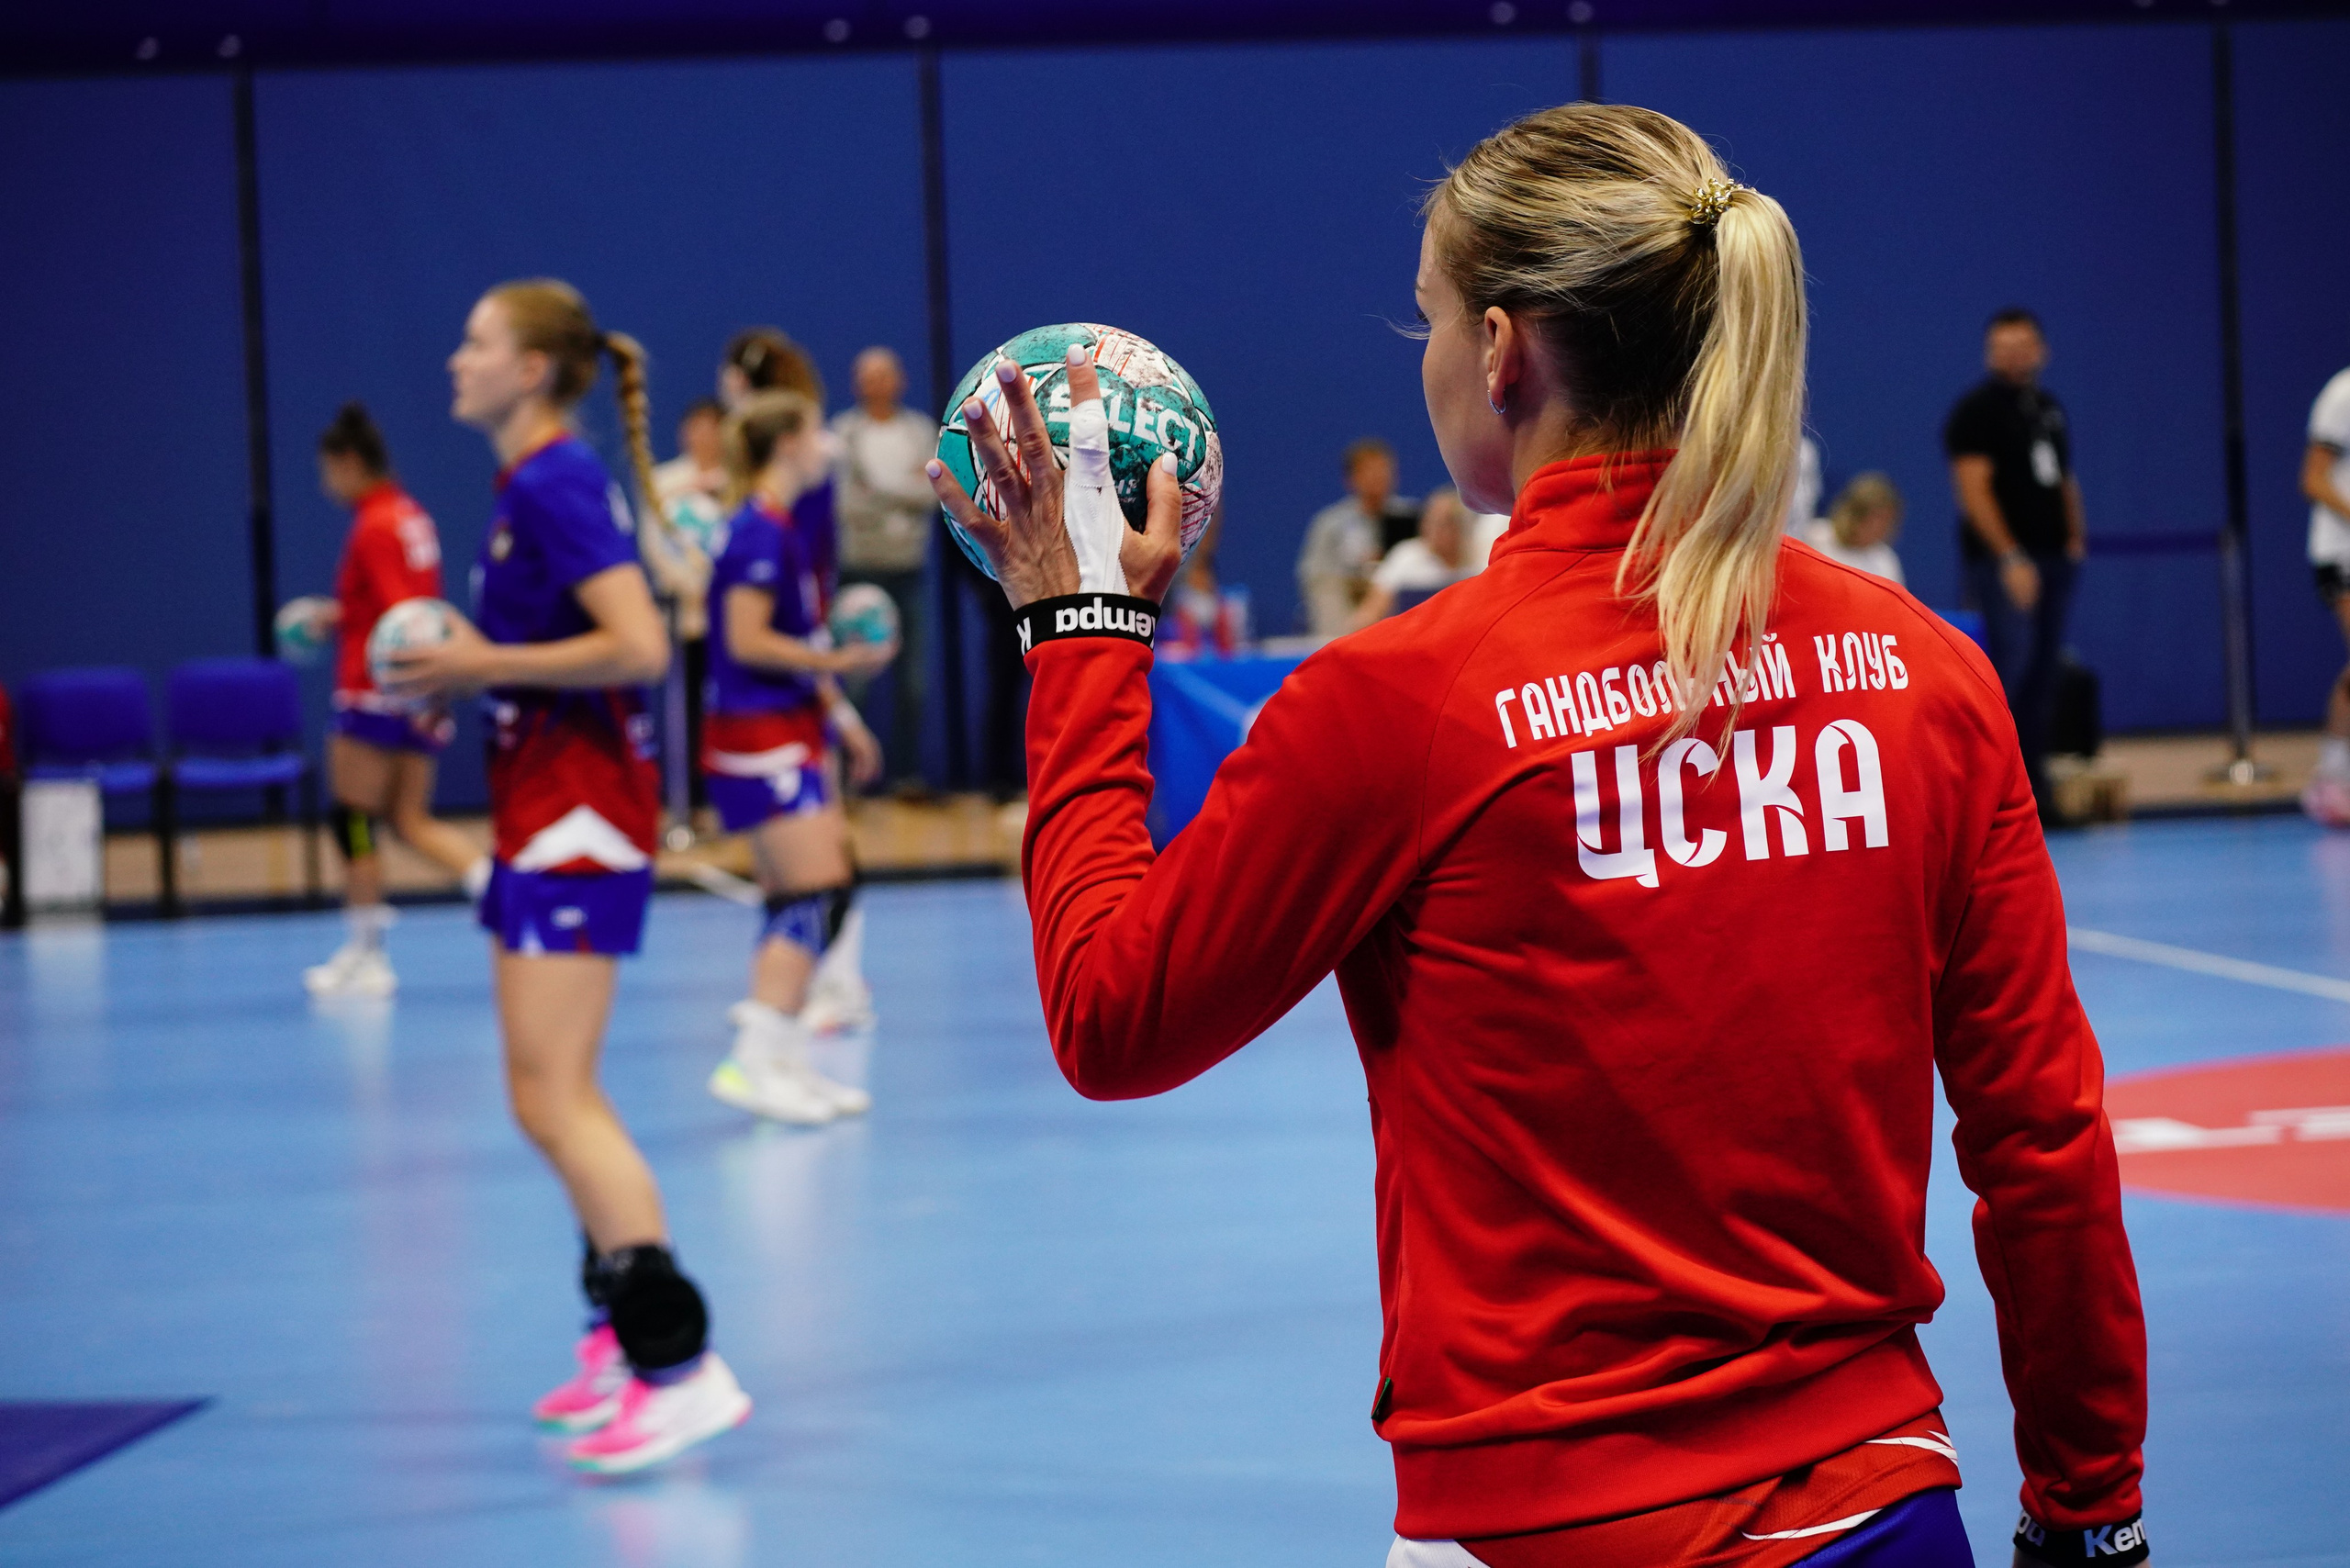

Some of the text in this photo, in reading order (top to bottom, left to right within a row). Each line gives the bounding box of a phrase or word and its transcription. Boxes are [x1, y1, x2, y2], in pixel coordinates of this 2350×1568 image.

[1048, 383, 1200, 462] SLECT
[1813, 632, 1908, 693] КЛУБ
[1571, 719, 1888, 888] ЦСКА
